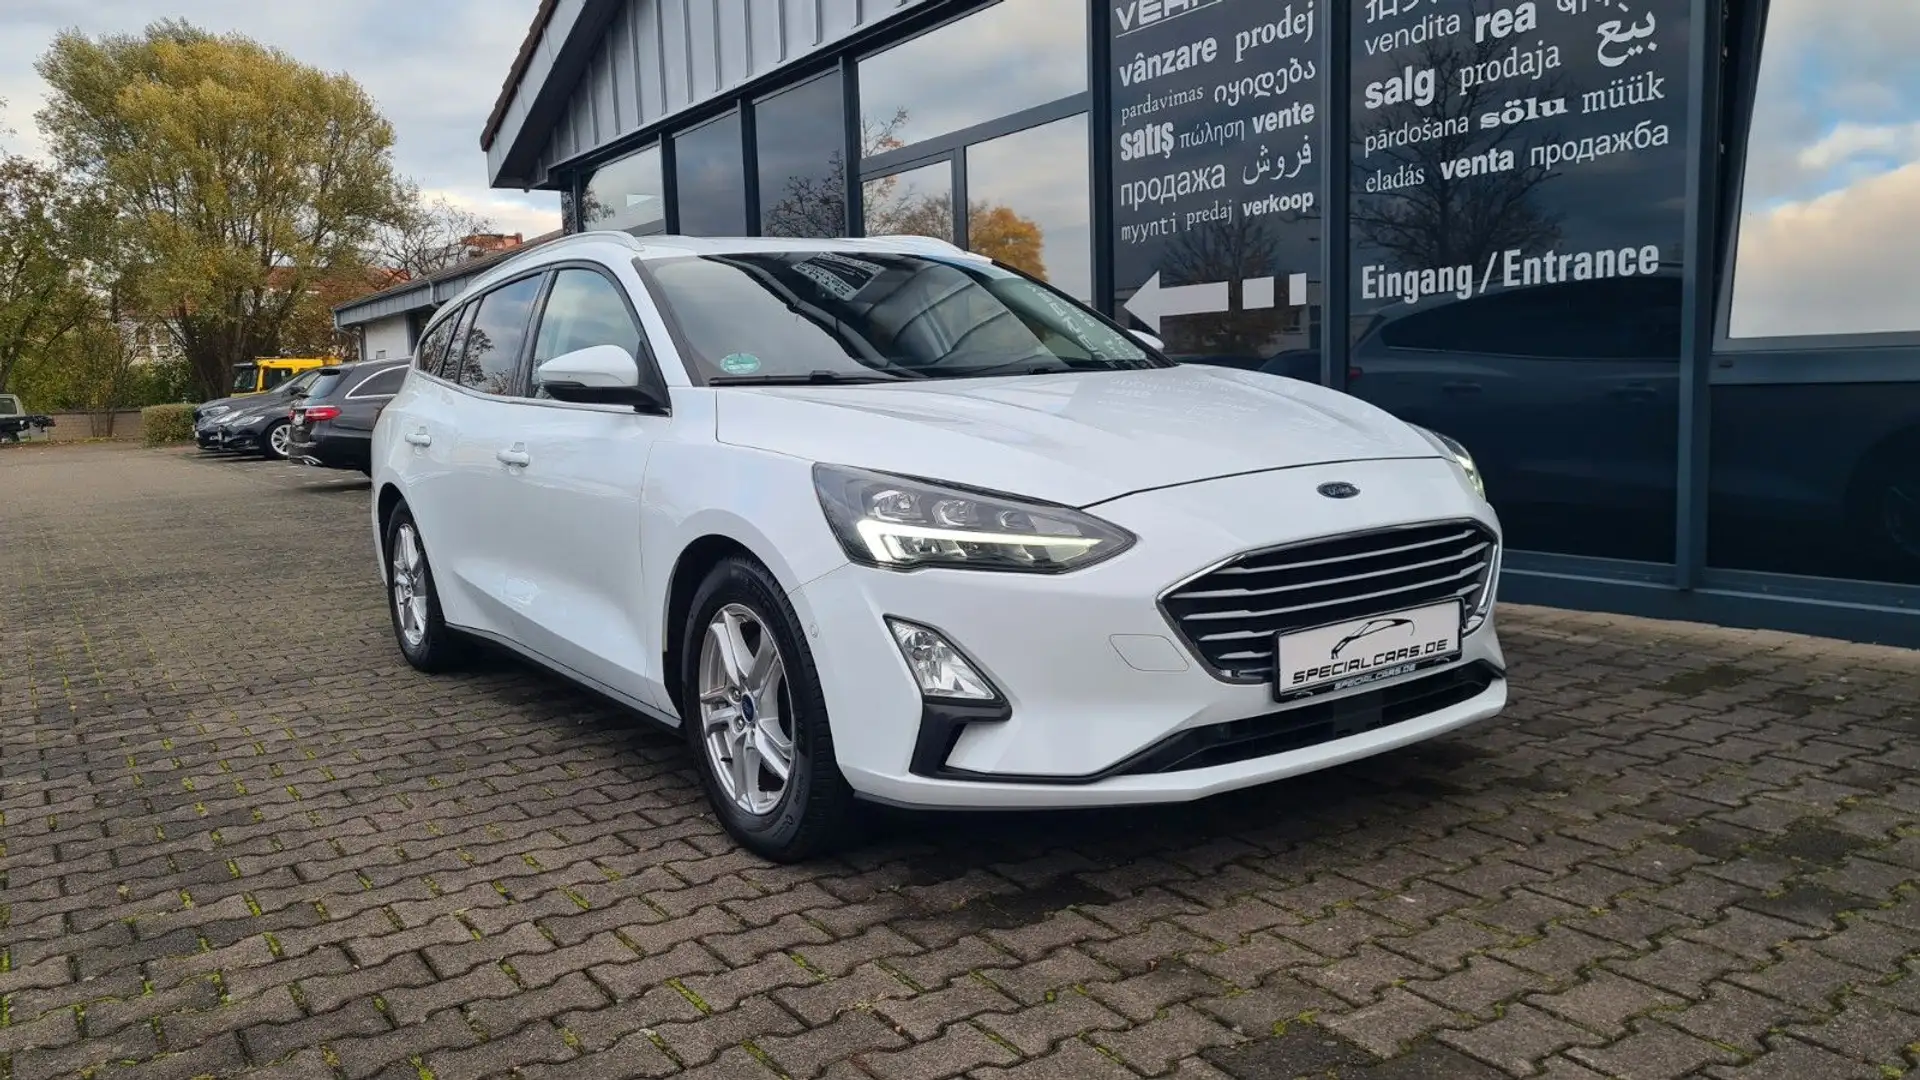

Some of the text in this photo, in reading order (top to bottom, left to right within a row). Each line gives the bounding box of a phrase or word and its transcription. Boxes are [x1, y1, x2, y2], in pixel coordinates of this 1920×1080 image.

[1119, 37, 1218, 87] vânzare
[1235, 0, 1314, 63] prodej
[1364, 13, 1461, 56] vendita
[1475, 1, 1536, 43] rea
[1596, 11, 1658, 67] بيع
[1214, 57, 1316, 107] იყიდება
[1364, 40, 1561, 109] salg prodaja
[1121, 86, 1204, 126] pardavimas
[1252, 102, 1315, 134] vente
[1364, 71, 1665, 158] pārdošana sölu müük
[1120, 121, 1174, 160] satış
[1179, 119, 1245, 148] πώληση
[1530, 120, 1669, 170] продажба
[1242, 135, 1312, 185] فروش
[1365, 149, 1514, 193] eladás venta
[1120, 163, 1226, 211] продажа
[1121, 191, 1314, 244] myynti predaj verkoop
[1361, 264, 1473, 304] Eingang
[1503, 244, 1659, 287] Entrance
[1292, 639, 1449, 685] SPECIALCARS.DE
